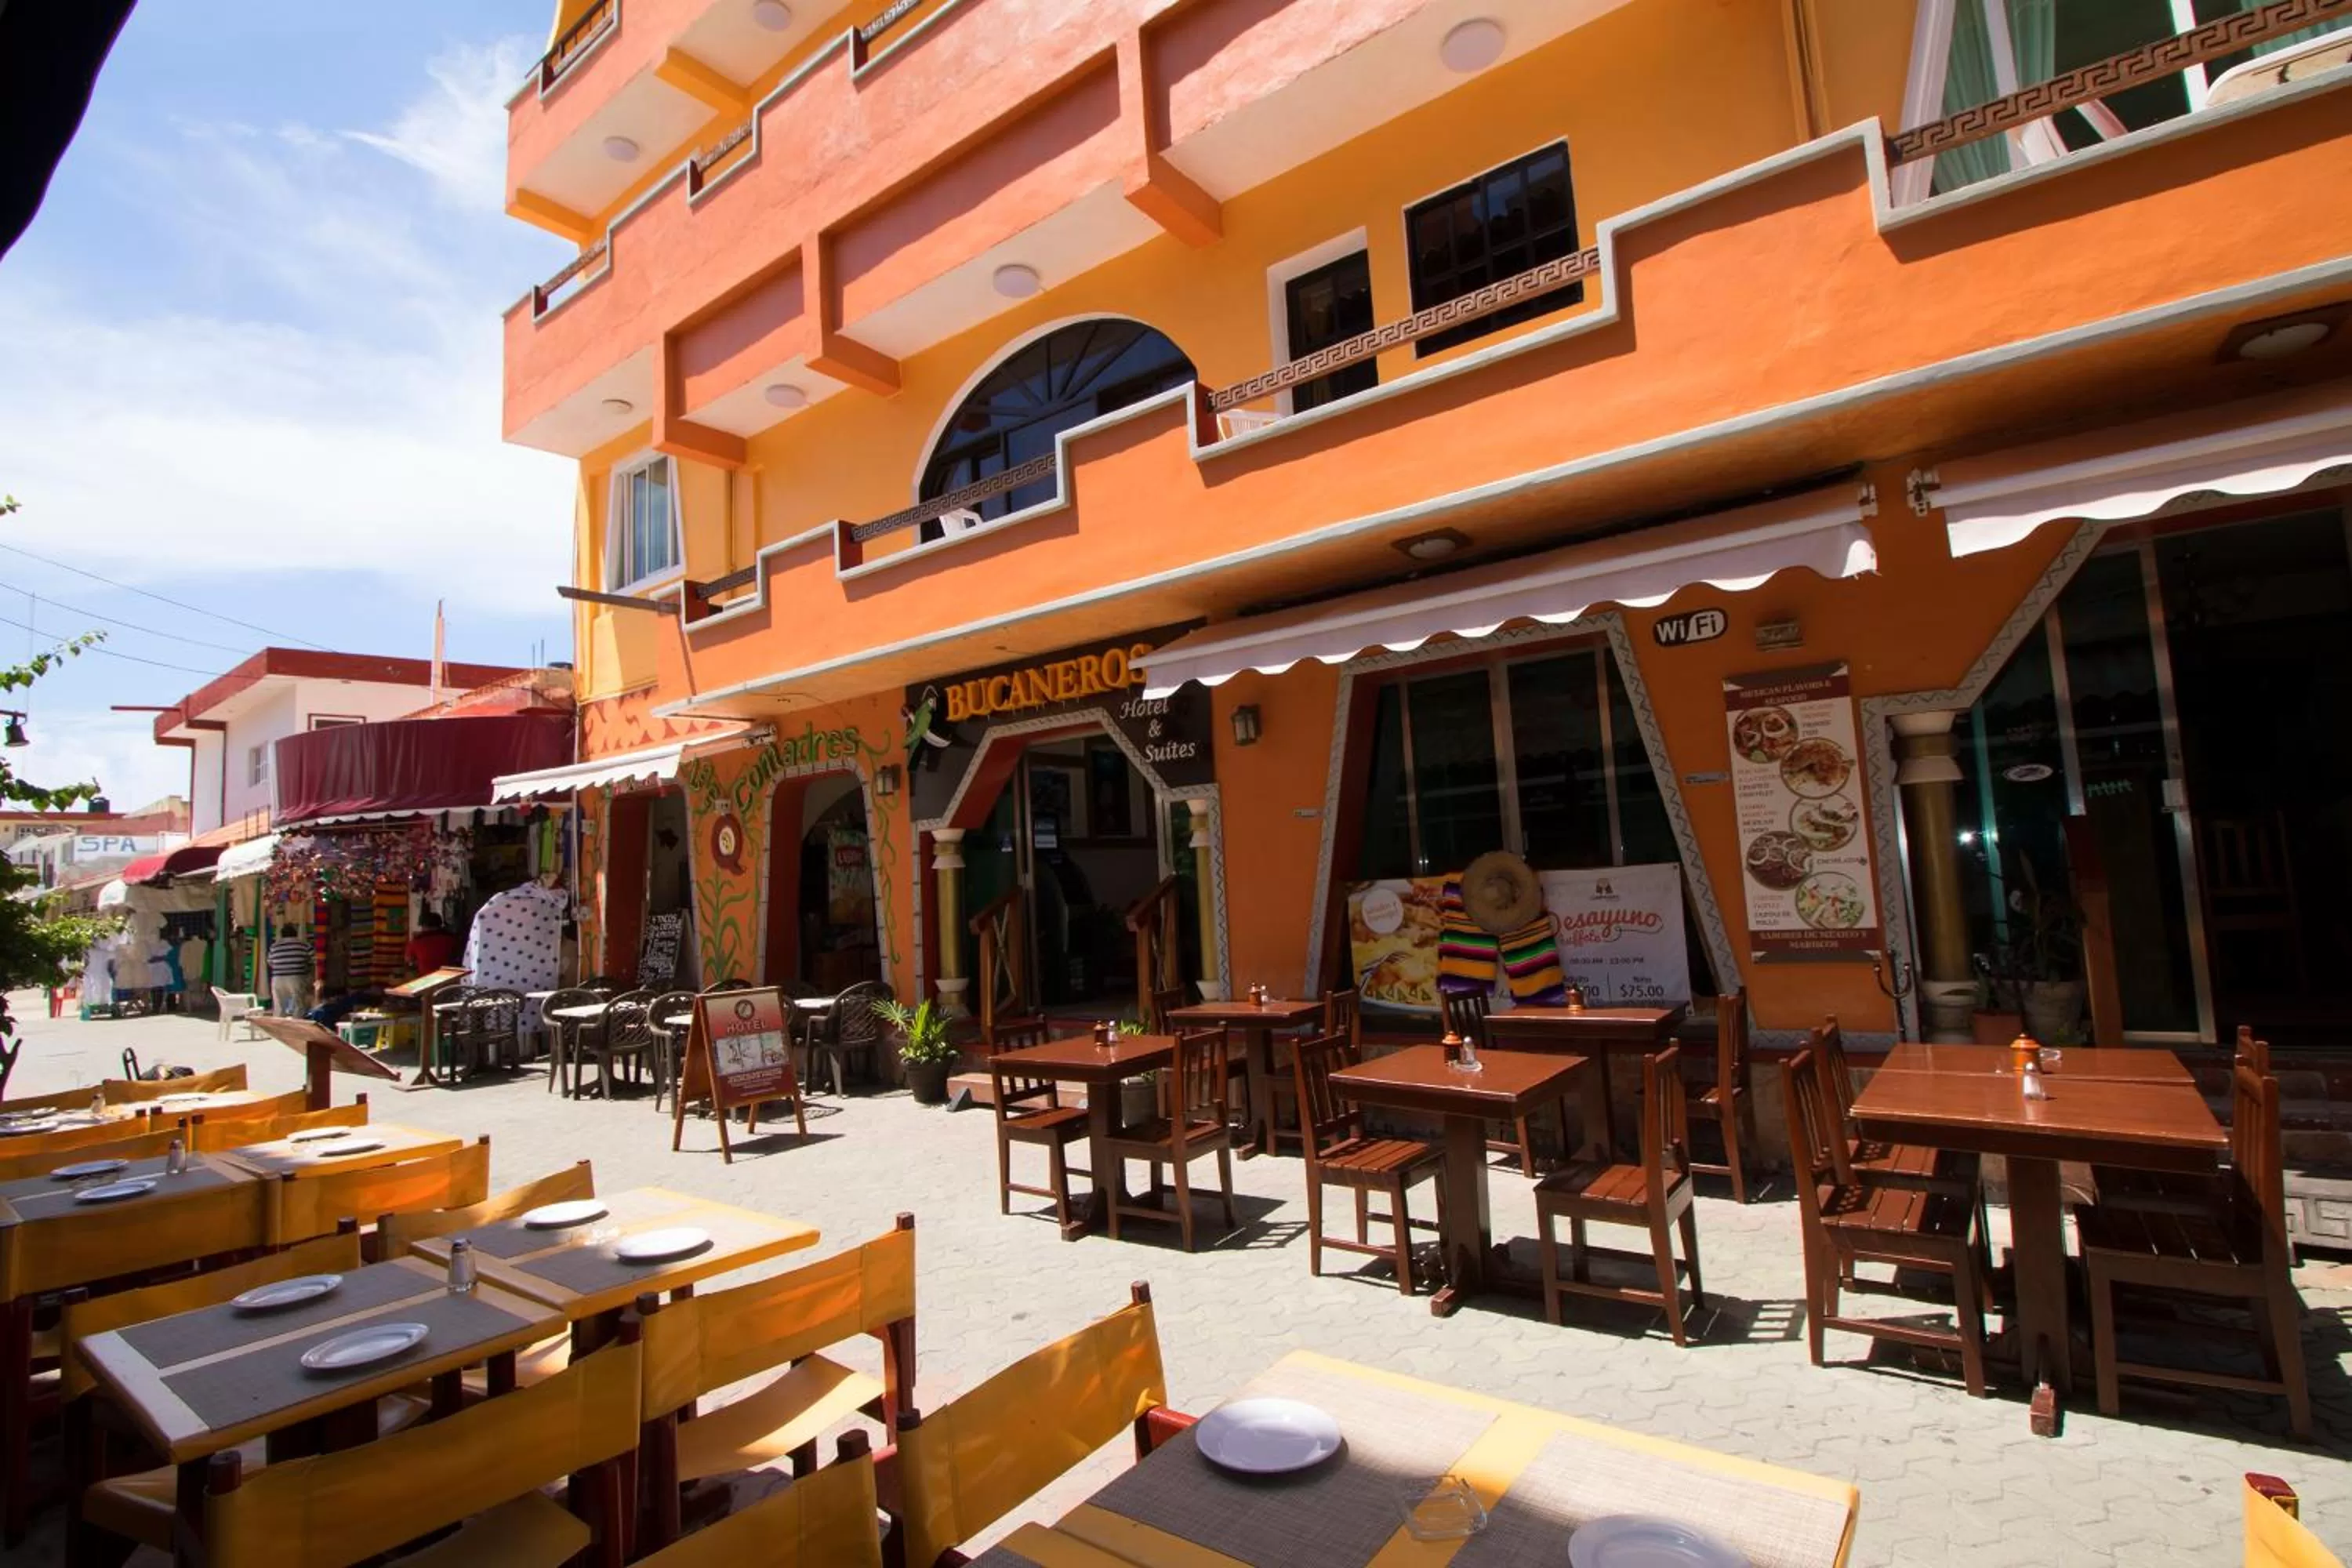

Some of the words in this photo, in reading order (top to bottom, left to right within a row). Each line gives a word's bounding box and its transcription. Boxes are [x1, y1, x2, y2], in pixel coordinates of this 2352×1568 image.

[946, 644, 1153, 721] BUCANEROS
[1119, 697, 1170, 720] Hotel
[1148, 719, 1162, 738] &
[1145, 741, 1196, 763] Suites
[78, 837, 137, 852] SPA
[1620, 984, 1664, 998] $75.00
[727, 1020, 768, 1033] HOTEL
